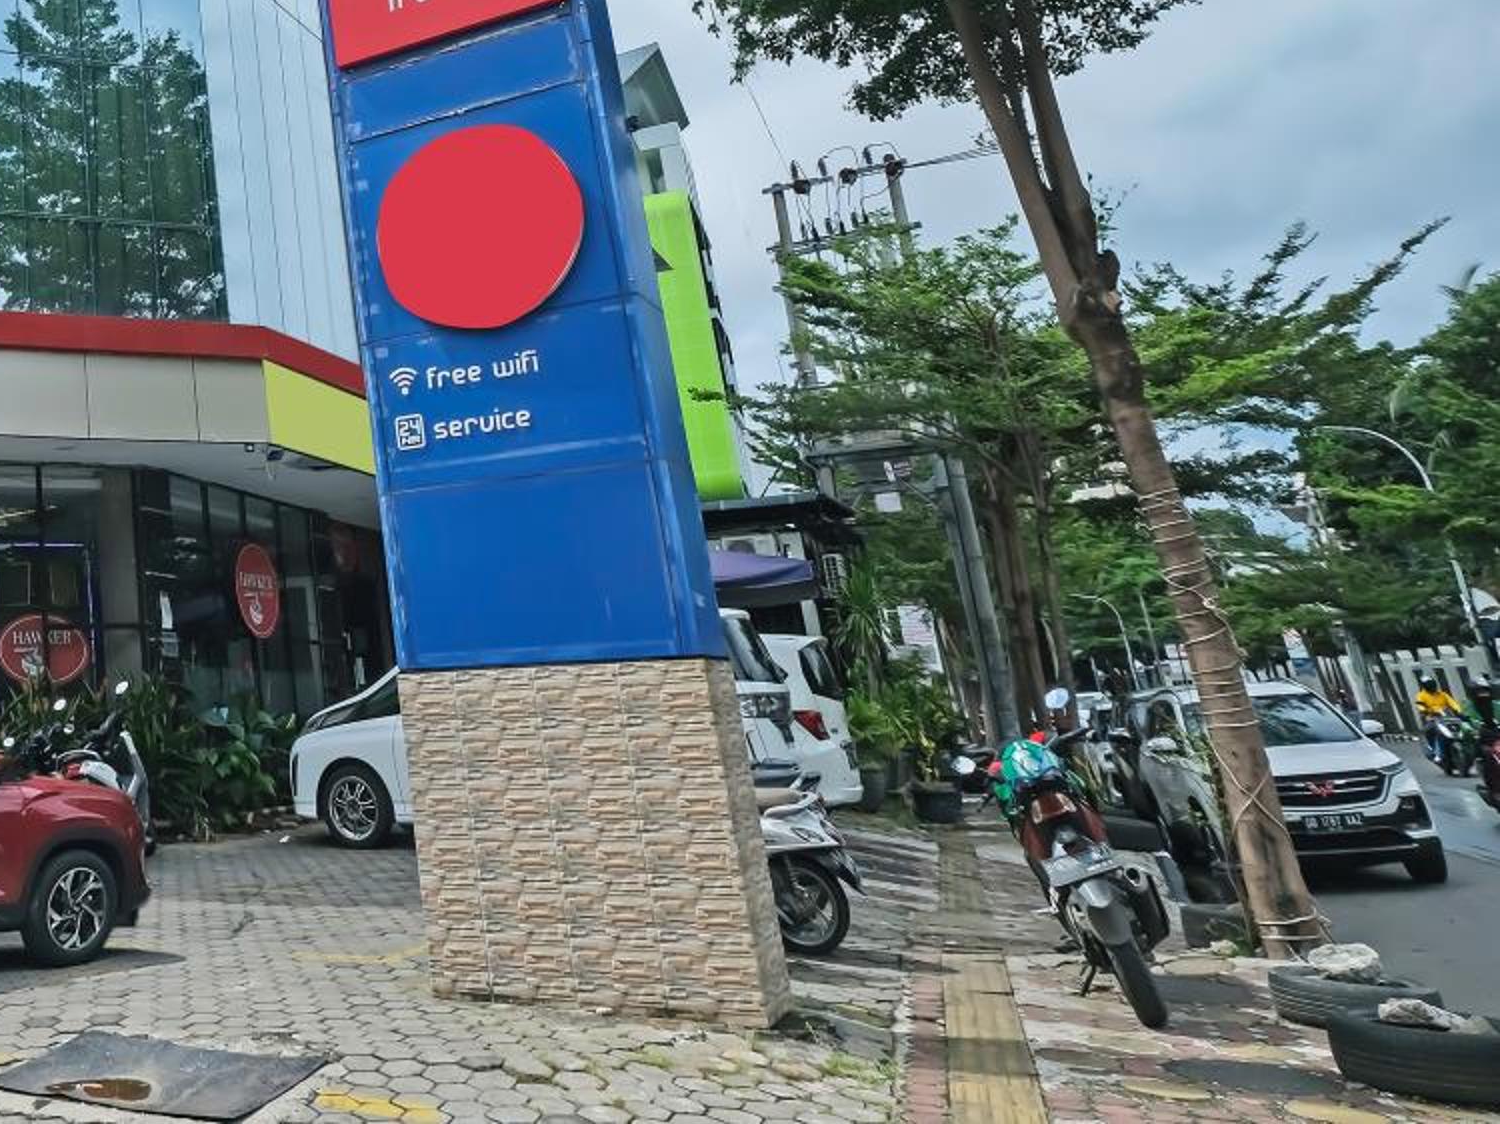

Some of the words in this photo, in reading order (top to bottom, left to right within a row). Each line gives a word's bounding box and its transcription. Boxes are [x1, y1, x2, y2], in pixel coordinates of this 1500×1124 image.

[426, 366, 481, 389] free
[492, 349, 540, 378] wifi
[433, 408, 531, 439] service
